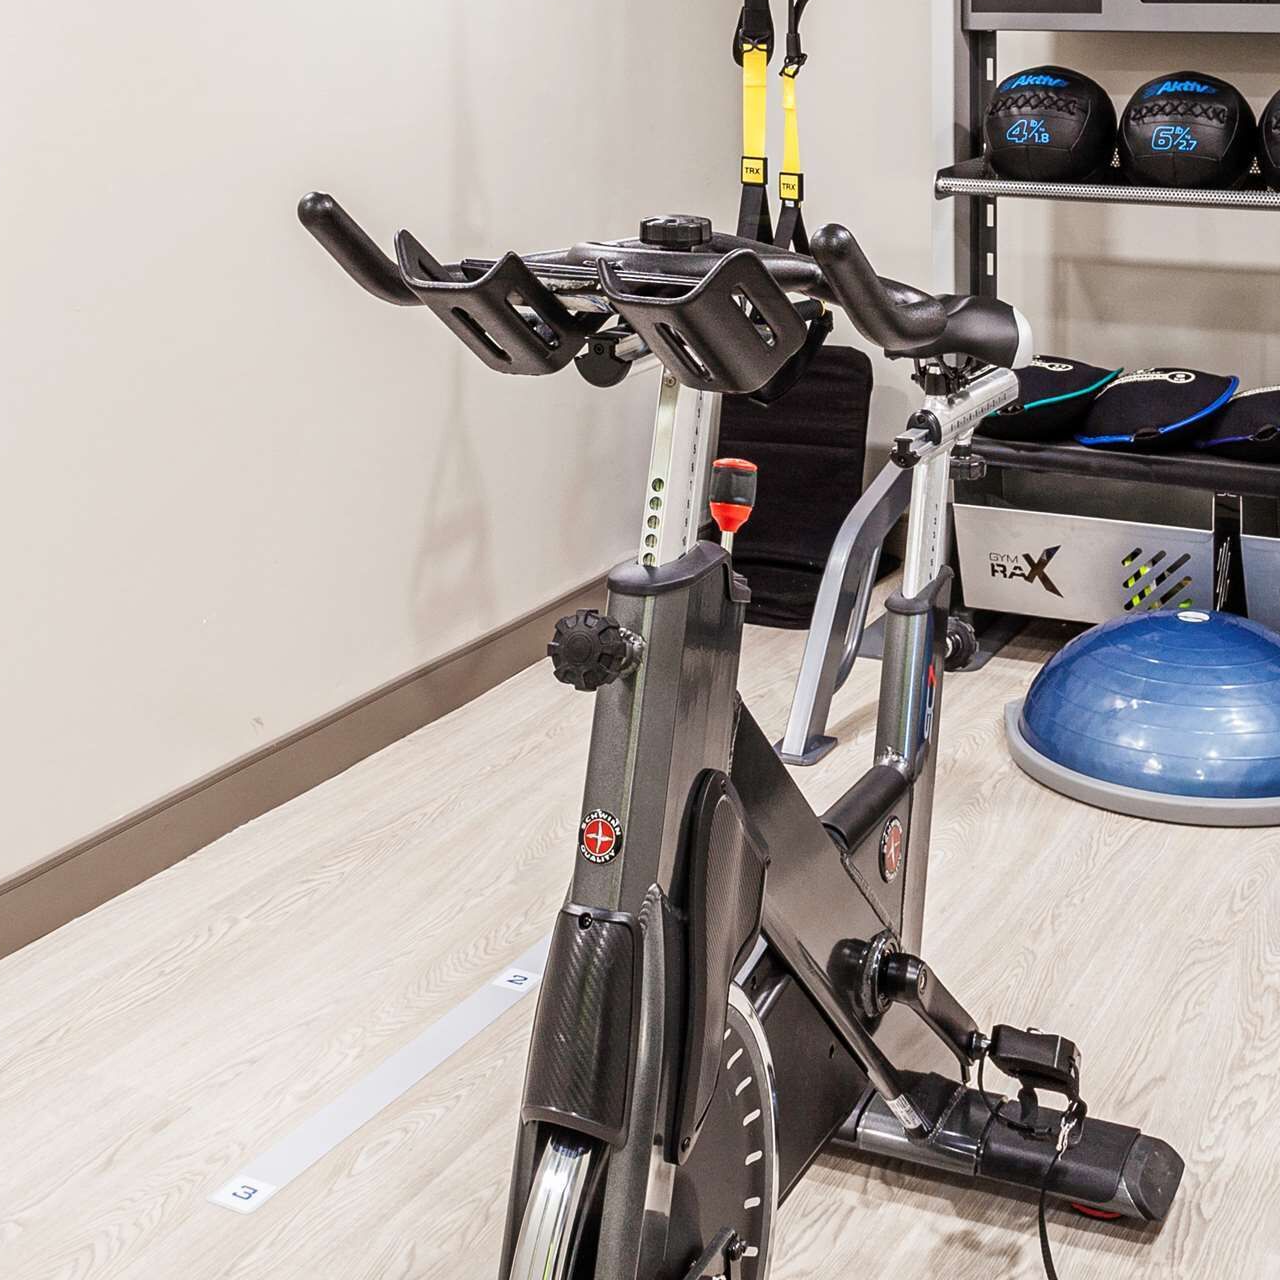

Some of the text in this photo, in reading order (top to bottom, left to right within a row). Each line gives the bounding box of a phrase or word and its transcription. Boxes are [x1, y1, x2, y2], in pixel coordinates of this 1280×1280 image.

[1006, 119, 1028, 143] 4
[1034, 133, 1049, 143] 1.8
[1152, 126, 1174, 150] 6
[1179, 140, 1197, 150] 2.7
[744, 166, 761, 176] TRX
[782, 182, 797, 192] TRX
[989, 552, 1019, 564] GYM
[581, 809, 621, 836] SCHWINN
[580, 844, 615, 863] QUALITY
[506, 974, 528, 985] 2
[232, 1185, 258, 1200] 3
